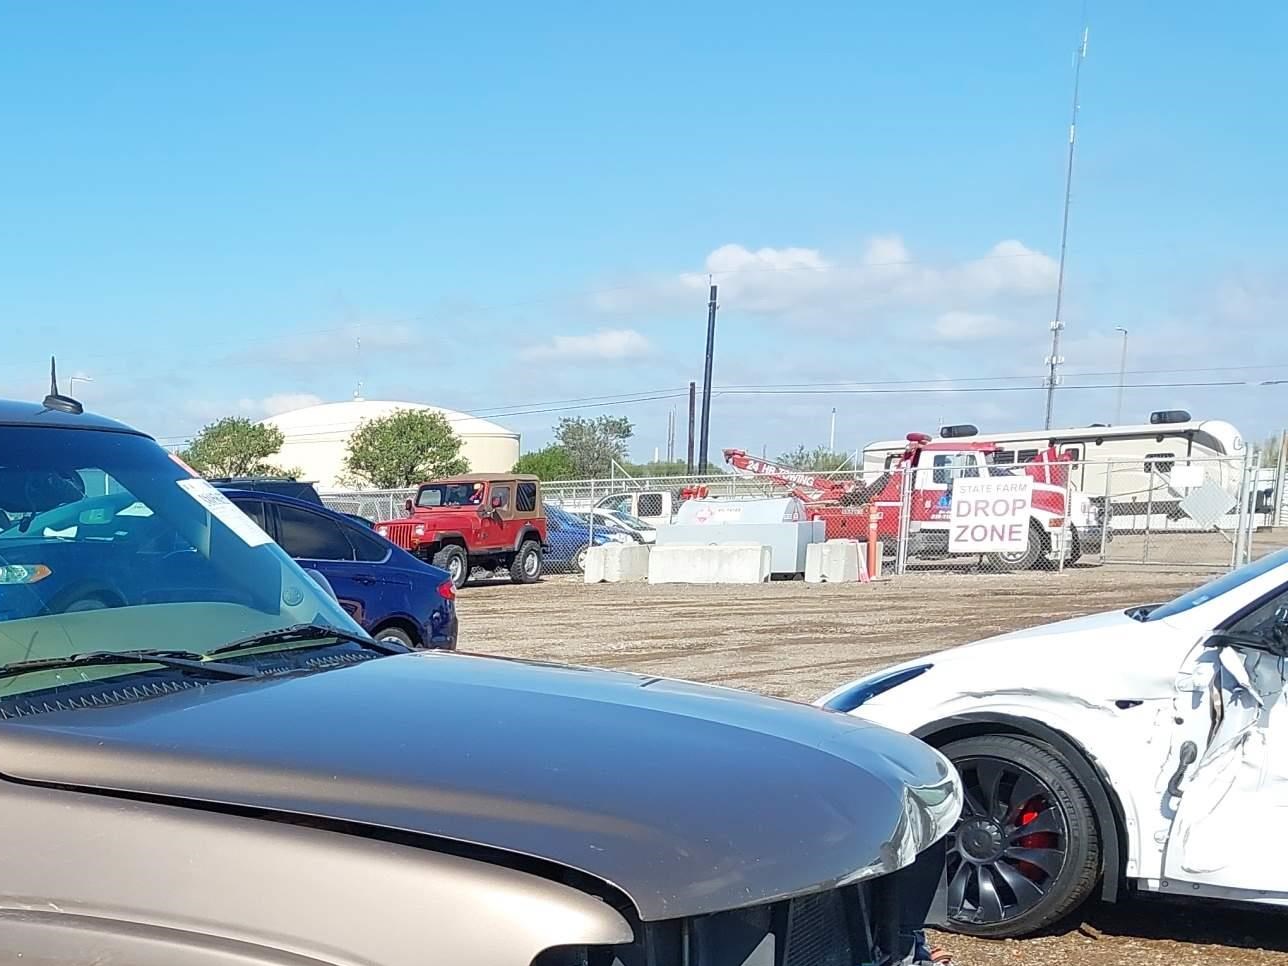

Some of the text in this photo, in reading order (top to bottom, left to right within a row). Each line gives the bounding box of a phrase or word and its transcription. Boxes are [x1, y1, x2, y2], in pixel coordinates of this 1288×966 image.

[746, 460, 814, 486] 24 HR TOWING
[959, 483, 1028, 494] STATE FARM
[956, 499, 1027, 517] DROP
[953, 524, 1023, 542] ZONE
